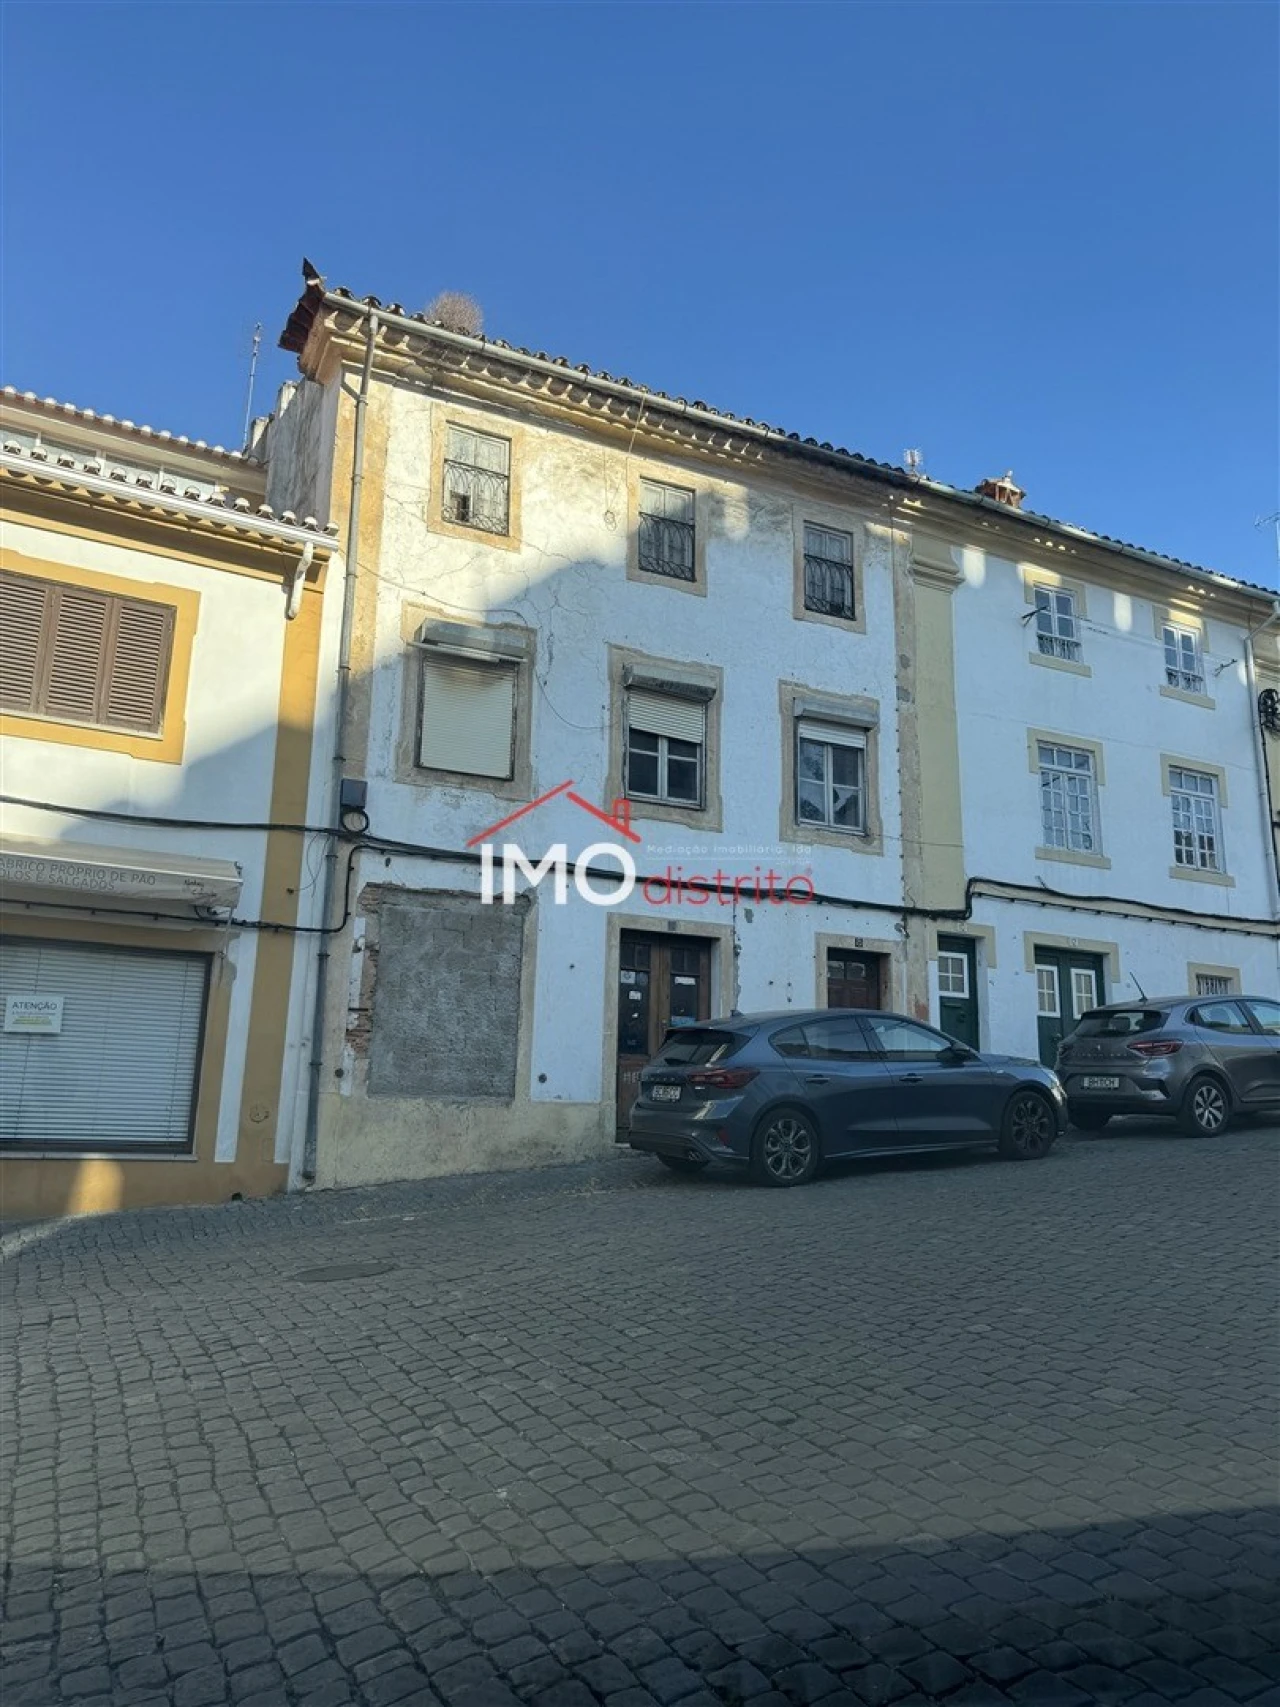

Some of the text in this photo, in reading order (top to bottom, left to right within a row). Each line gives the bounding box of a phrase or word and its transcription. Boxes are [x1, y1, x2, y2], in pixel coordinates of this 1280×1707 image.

[36, 872, 44, 882] E
[49, 874, 115, 891] SALGADOS
[110, 870, 126, 882] DE
[12, 1001, 58, 1011] ATENÇÃO
